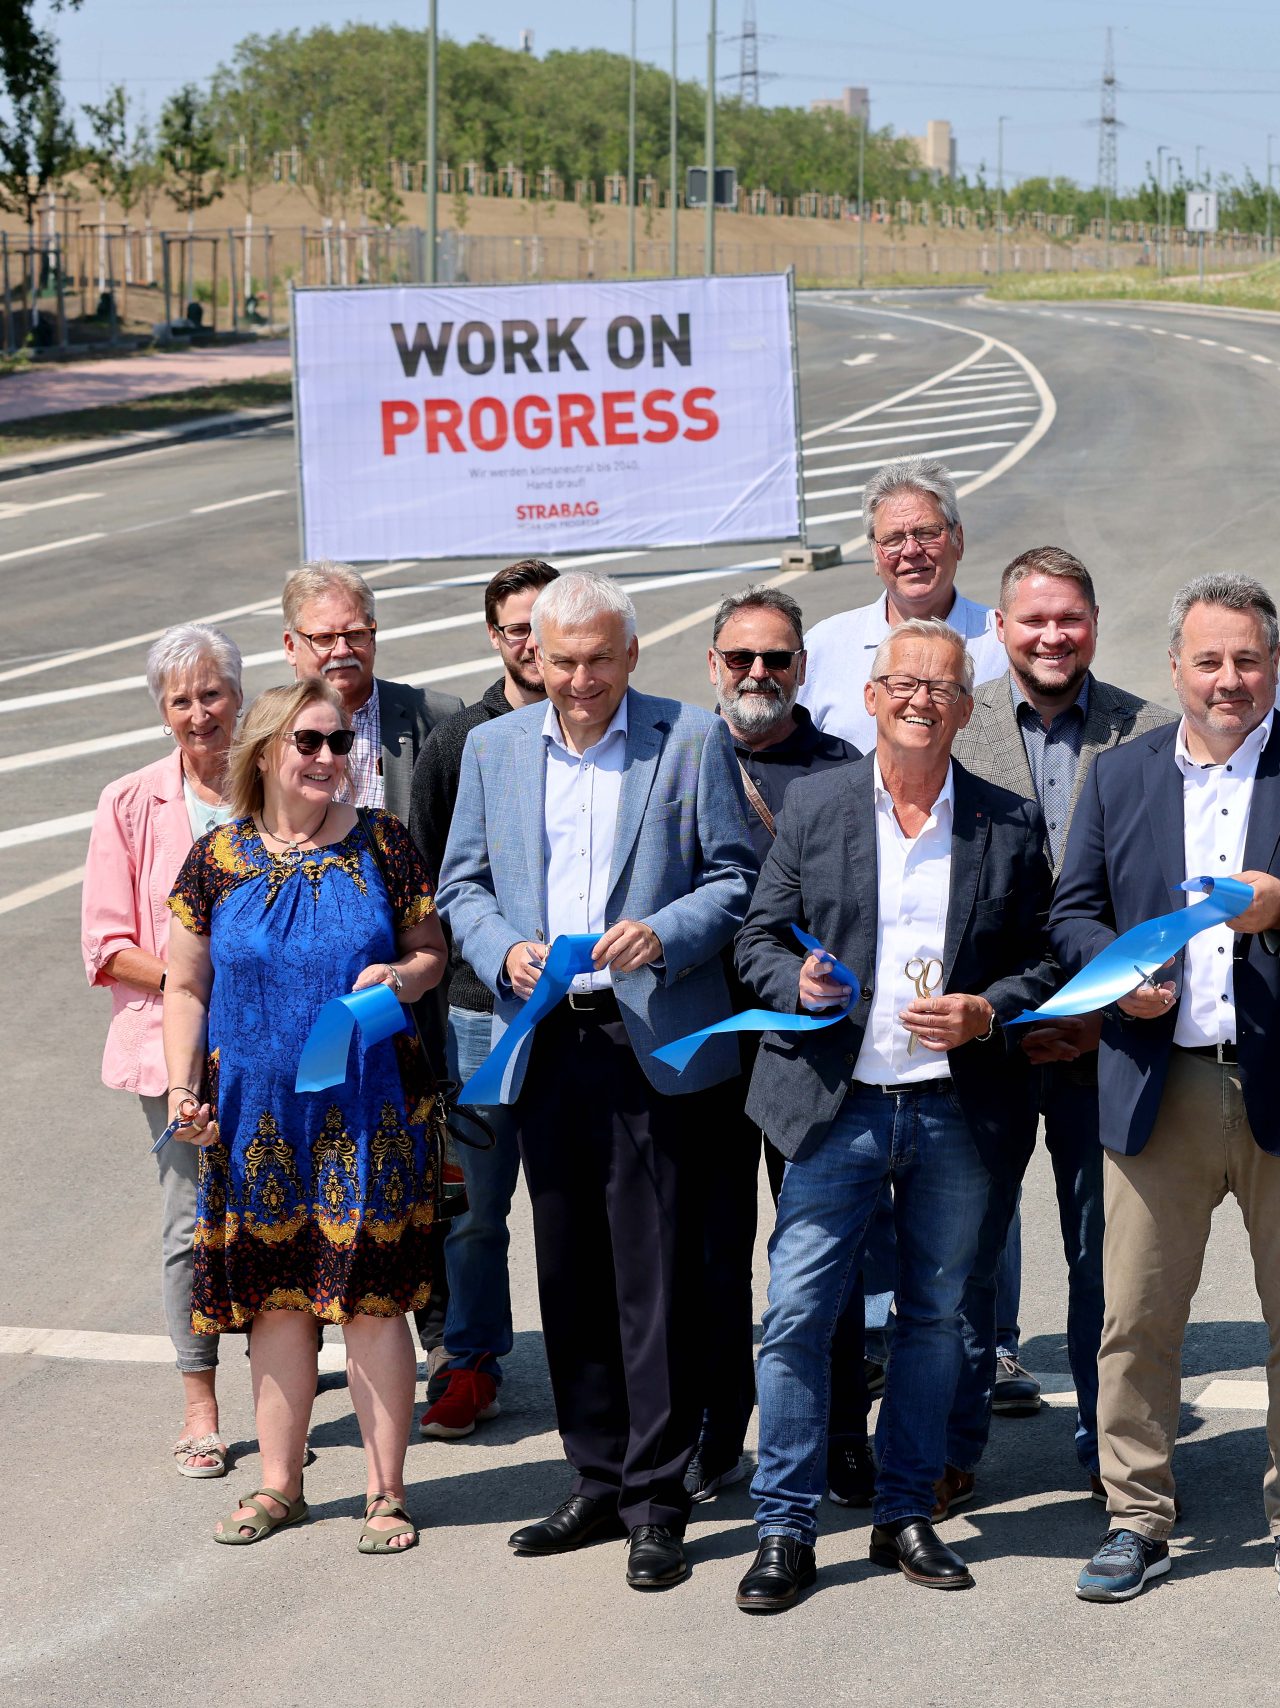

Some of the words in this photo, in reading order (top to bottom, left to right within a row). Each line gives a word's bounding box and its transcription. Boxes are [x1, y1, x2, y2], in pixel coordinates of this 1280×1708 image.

[390, 316, 590, 378] WORK
[606, 312, 693, 370] ON
[380, 386, 720, 456] PROGRESS
[468, 468, 487, 478] Wir
[490, 466, 527, 477] werden
[530, 462, 595, 475] klimaneutral
[596, 461, 612, 472] bis
[526, 480, 553, 490] Hand
[516, 501, 600, 520] STRABAG
